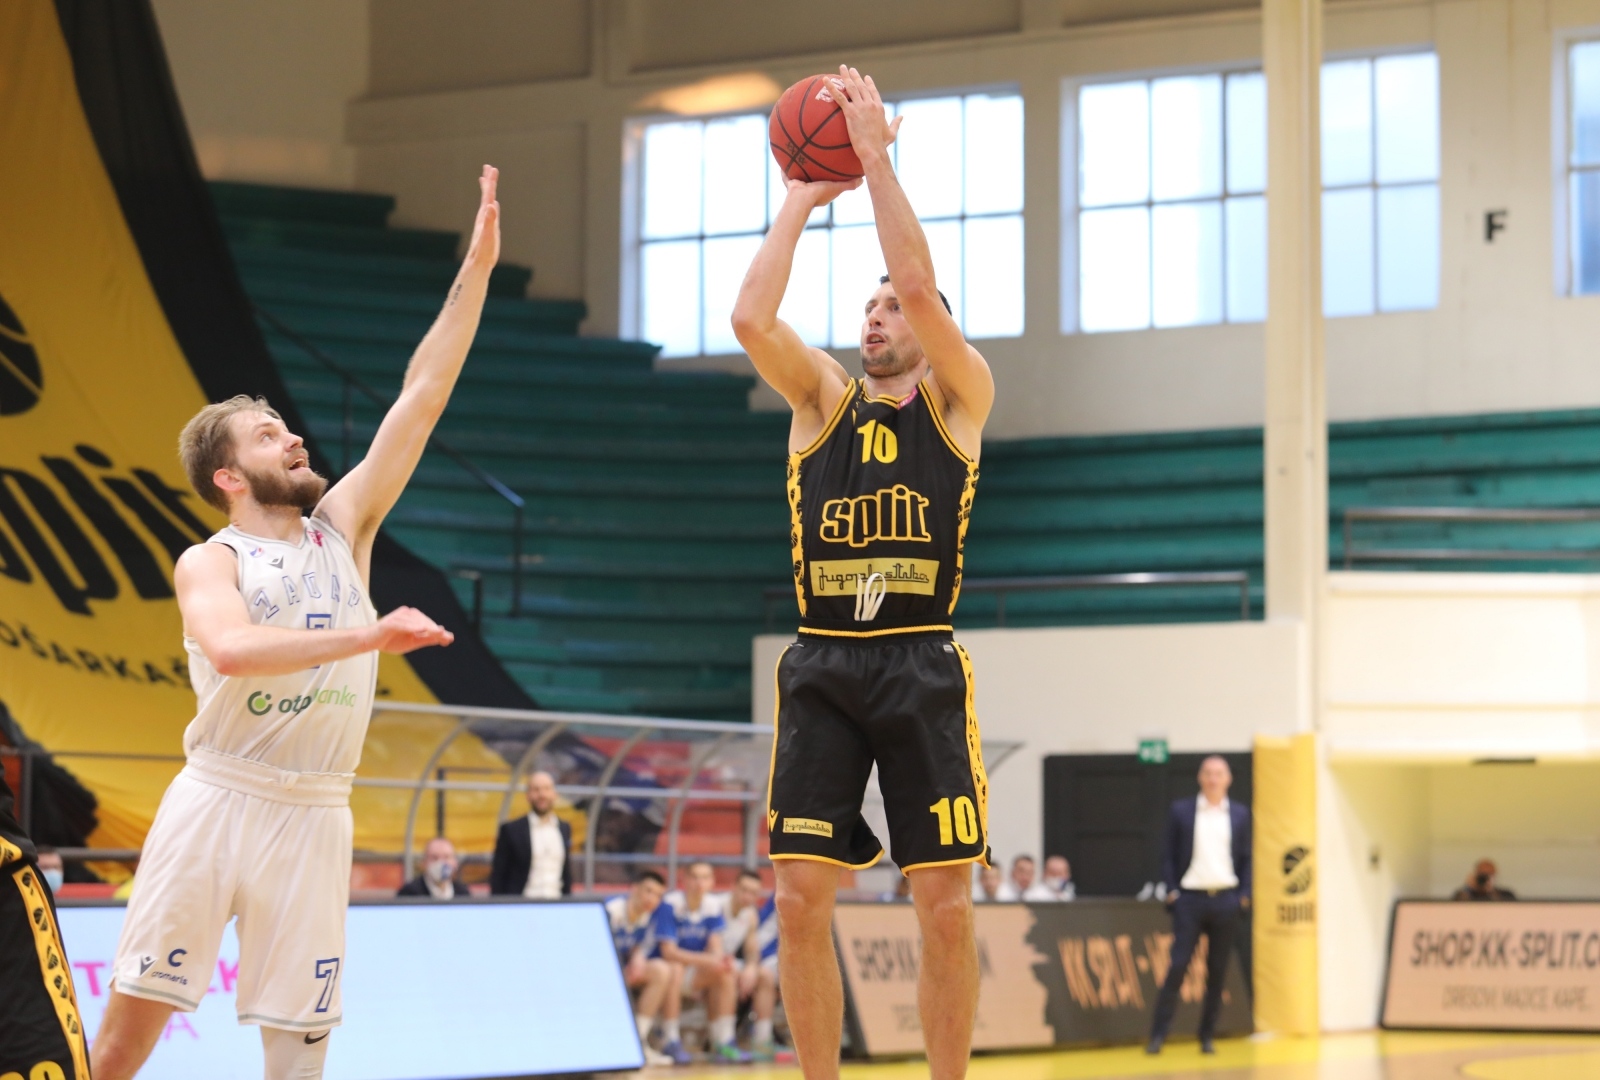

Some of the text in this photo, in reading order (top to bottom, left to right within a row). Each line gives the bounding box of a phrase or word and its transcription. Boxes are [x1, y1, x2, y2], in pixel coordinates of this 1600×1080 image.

[1484, 208, 1508, 242] F
[857, 419, 898, 464] 10
[0, 443, 215, 617] plit
[819, 484, 932, 548] split
[278, 694, 313, 715] otp
[929, 795, 979, 846] 10
[1410, 929, 1600, 969] SHOP.KK-SPLIT.C
[314, 957, 340, 1013] 7
